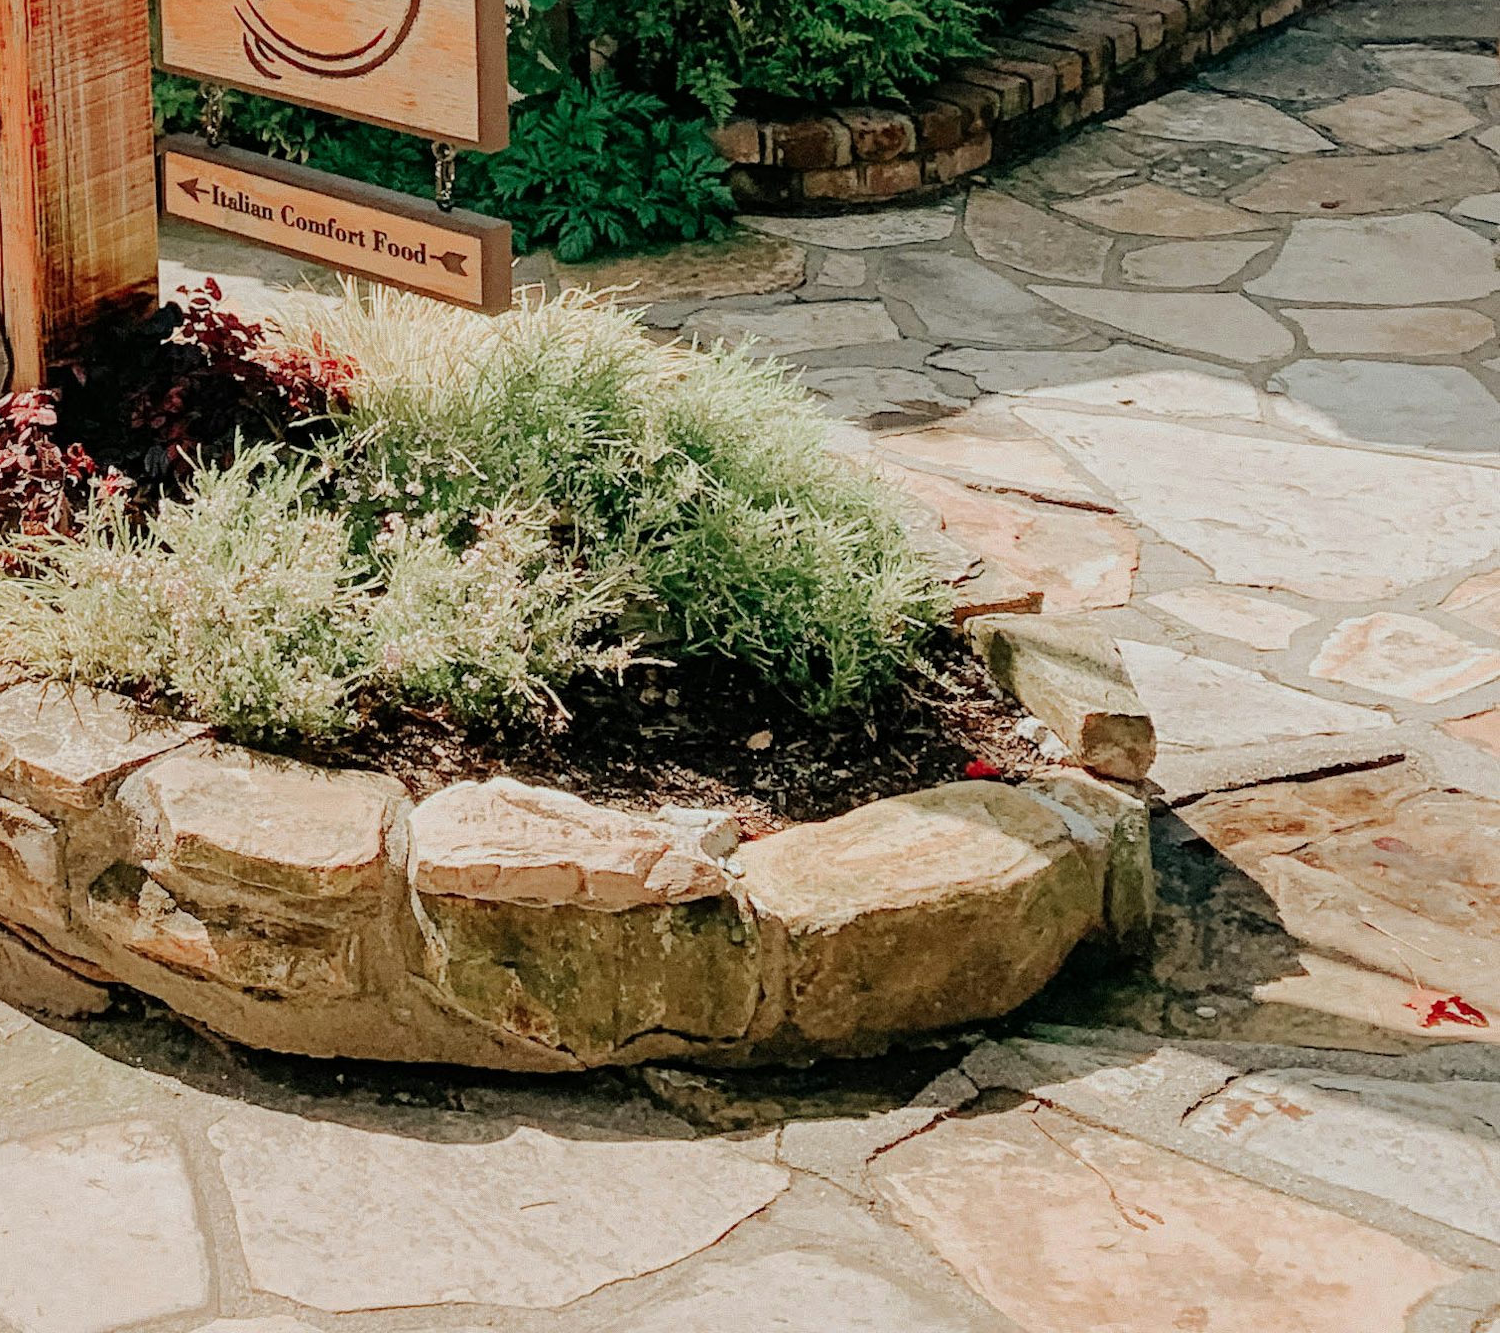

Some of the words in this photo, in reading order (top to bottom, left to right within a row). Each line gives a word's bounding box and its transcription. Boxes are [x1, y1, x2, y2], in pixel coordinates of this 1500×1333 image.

[210, 183, 275, 222] Italian
[280, 204, 366, 248] Comfort
[371, 229, 428, 266] Food
